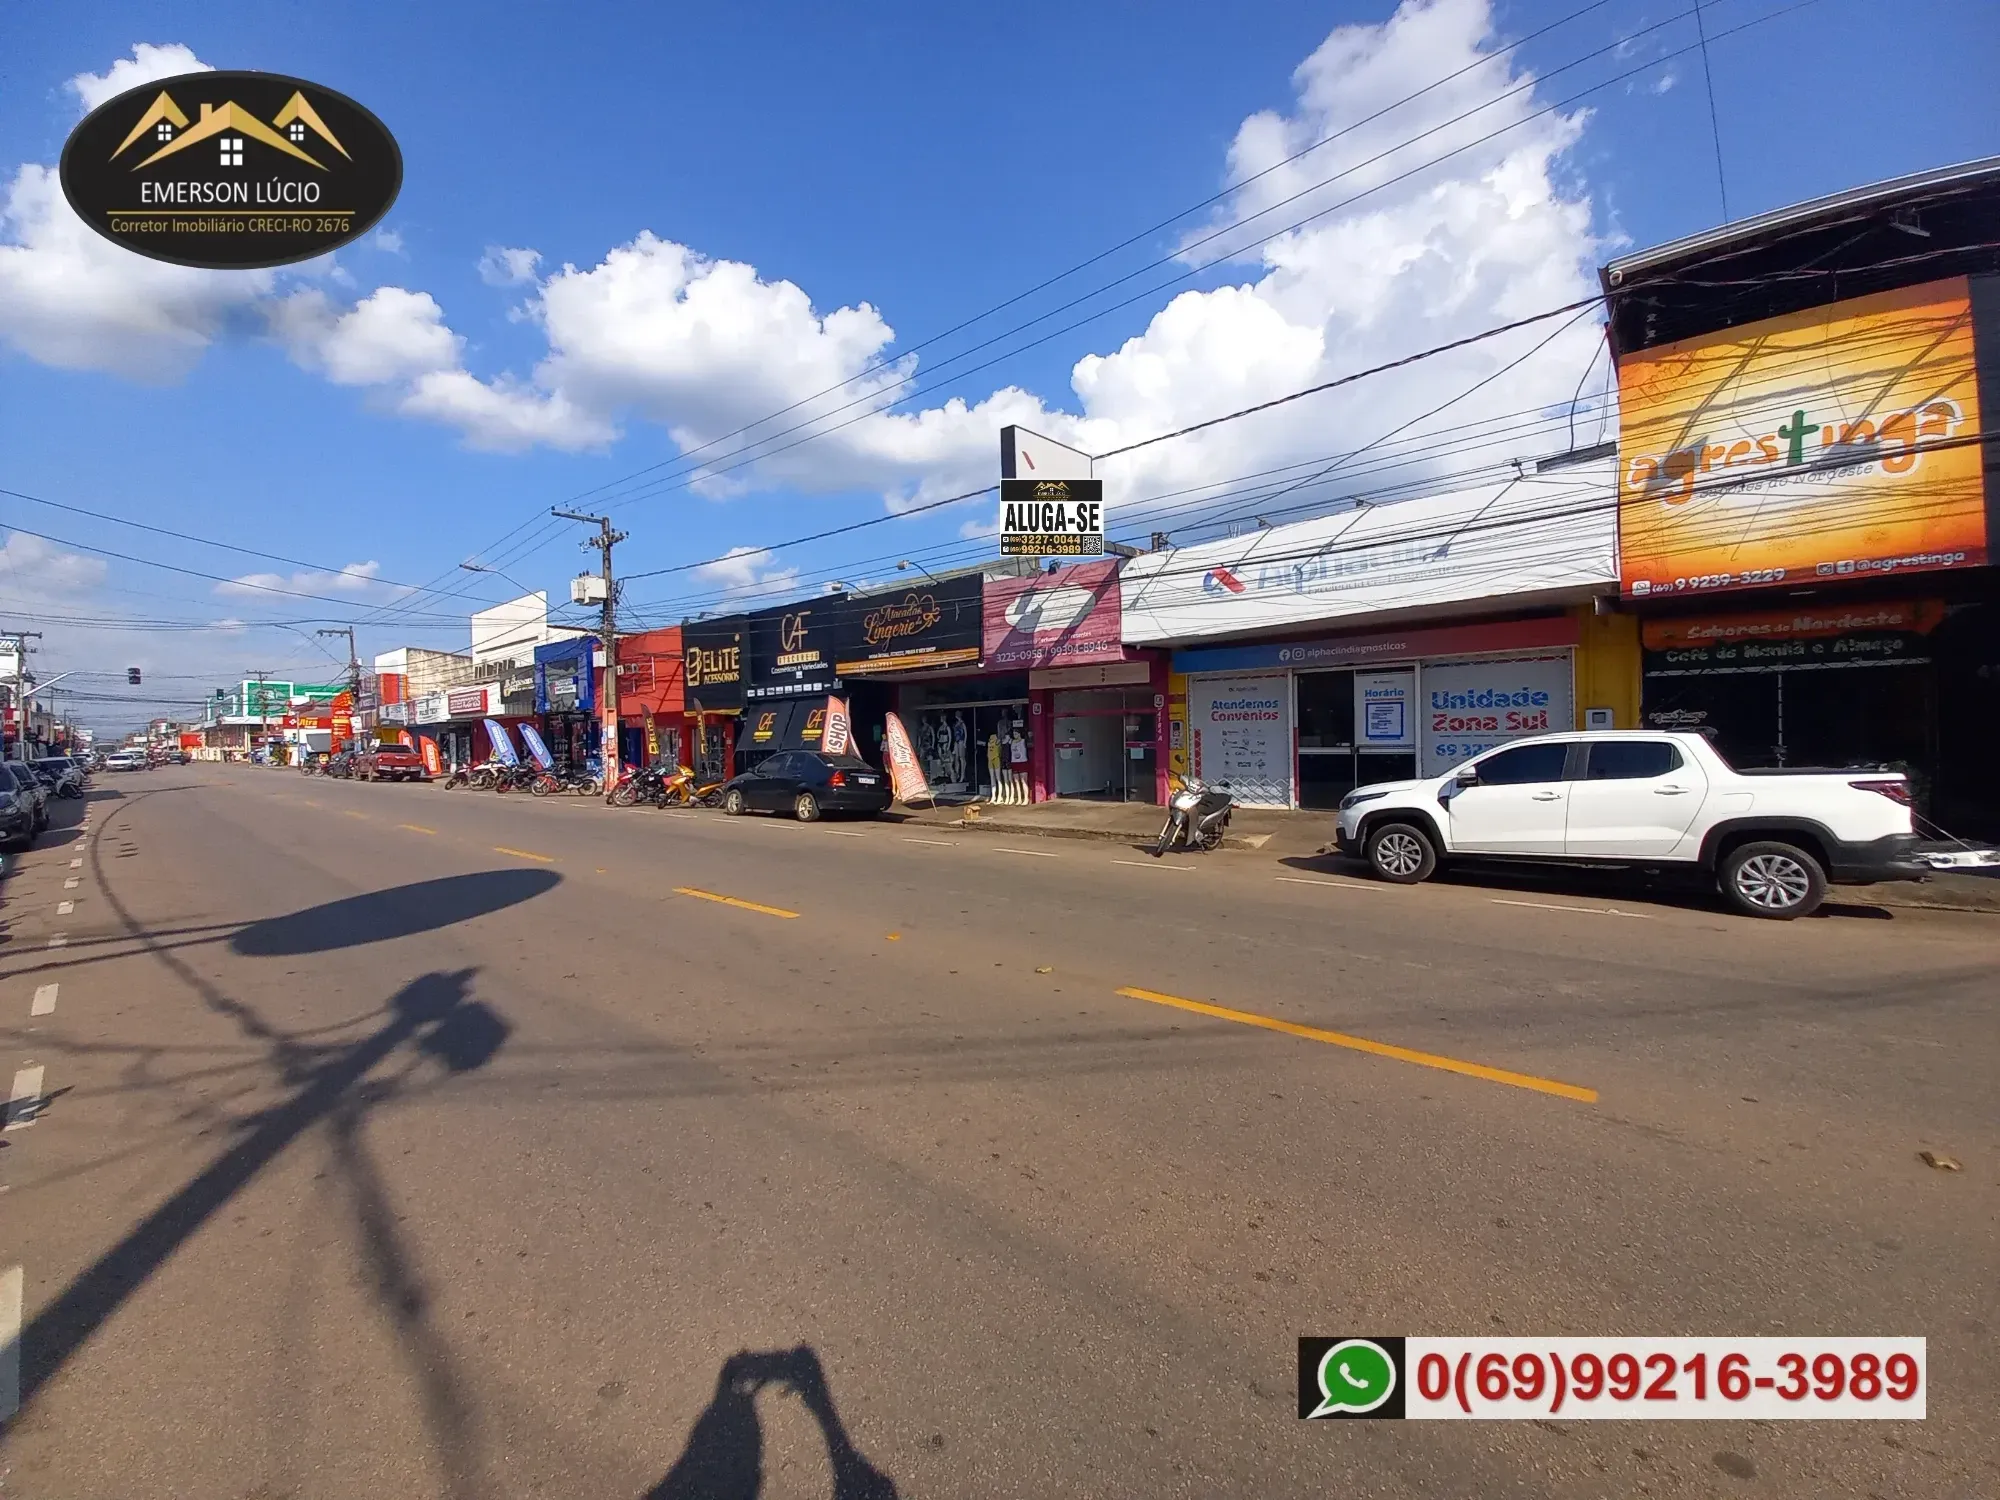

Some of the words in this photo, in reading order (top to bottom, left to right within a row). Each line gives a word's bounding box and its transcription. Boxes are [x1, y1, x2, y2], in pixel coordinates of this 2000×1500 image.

[1856, 551, 1966, 572] @agrestinga
[1675, 579, 1686, 591] 9
[1689, 568, 1786, 589] 9239-3229
[1687, 622, 1777, 640] Sabores
[1792, 611, 1903, 632] Nordeste
[995, 649, 1043, 663] 3225-0958
[1050, 640, 1108, 657] 99394-8946
[1364, 688, 1404, 698] Horário
[1431, 687, 1549, 710] Unidade
[1210, 710, 1280, 722] Convênios
[1211, 699, 1280, 711] Atendemos
[828, 713, 848, 749] SHOP
[1432, 713, 1499, 732] Zona
[1505, 709, 1549, 731] Sul
